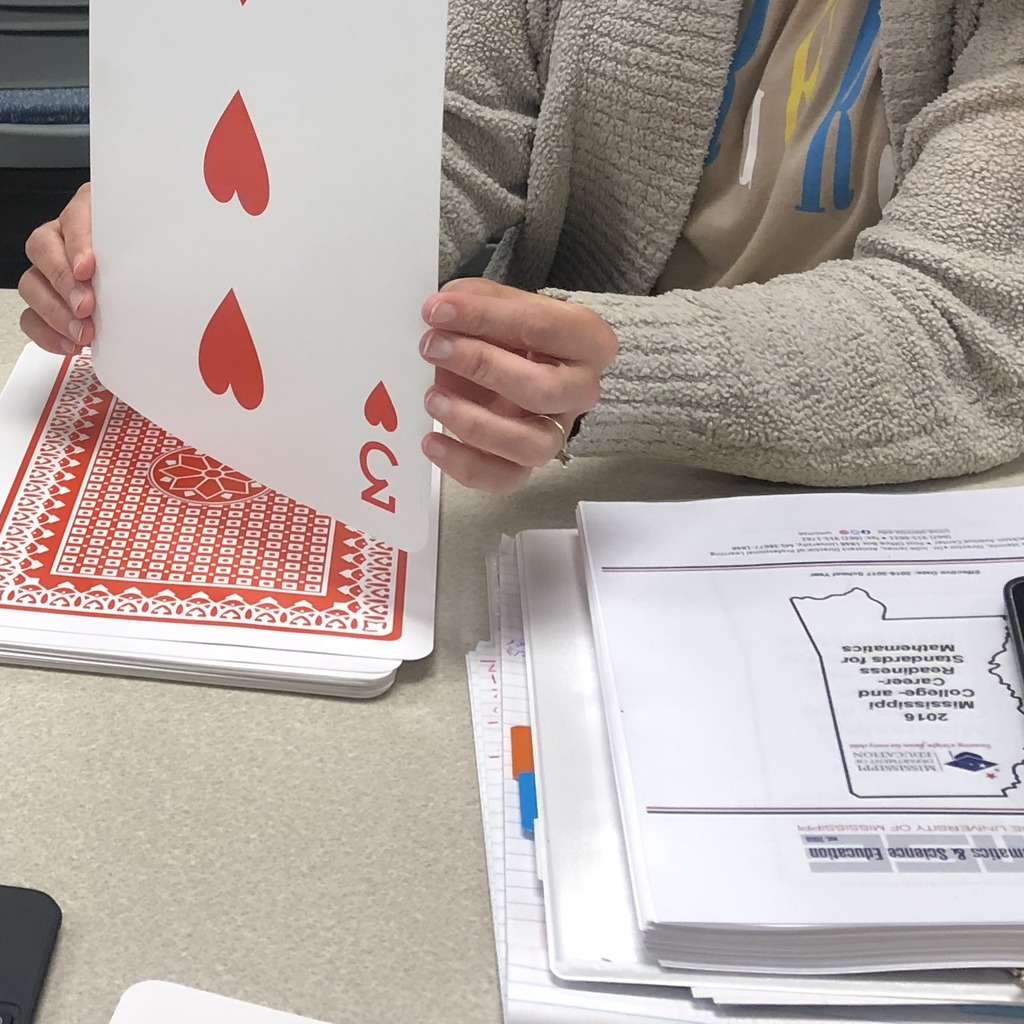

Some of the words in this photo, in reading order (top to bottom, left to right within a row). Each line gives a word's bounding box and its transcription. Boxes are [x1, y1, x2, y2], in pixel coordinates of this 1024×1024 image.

[359, 441, 397, 514] 3
[841, 643, 956, 654] Mathematics
[840, 655, 868, 665] for
[872, 654, 964, 664] Standards
[859, 666, 955, 675] Readiness
[878, 677, 946, 686] Career-
[858, 689, 894, 699] and
[898, 687, 976, 698] College-
[869, 699, 975, 711] Mississippi
[904, 712, 949, 722] 2016
[852, 751, 932, 759] EDUCATION
[856, 763, 937, 773] MISSISSIPPI
[796, 824, 886, 833] MISSISSIPPI
[890, 824, 912, 832] OF
[916, 824, 1007, 833] UNIVERSITY
[808, 846, 884, 861] Education
[886, 847, 949, 861] Science
[953, 847, 967, 861] &
